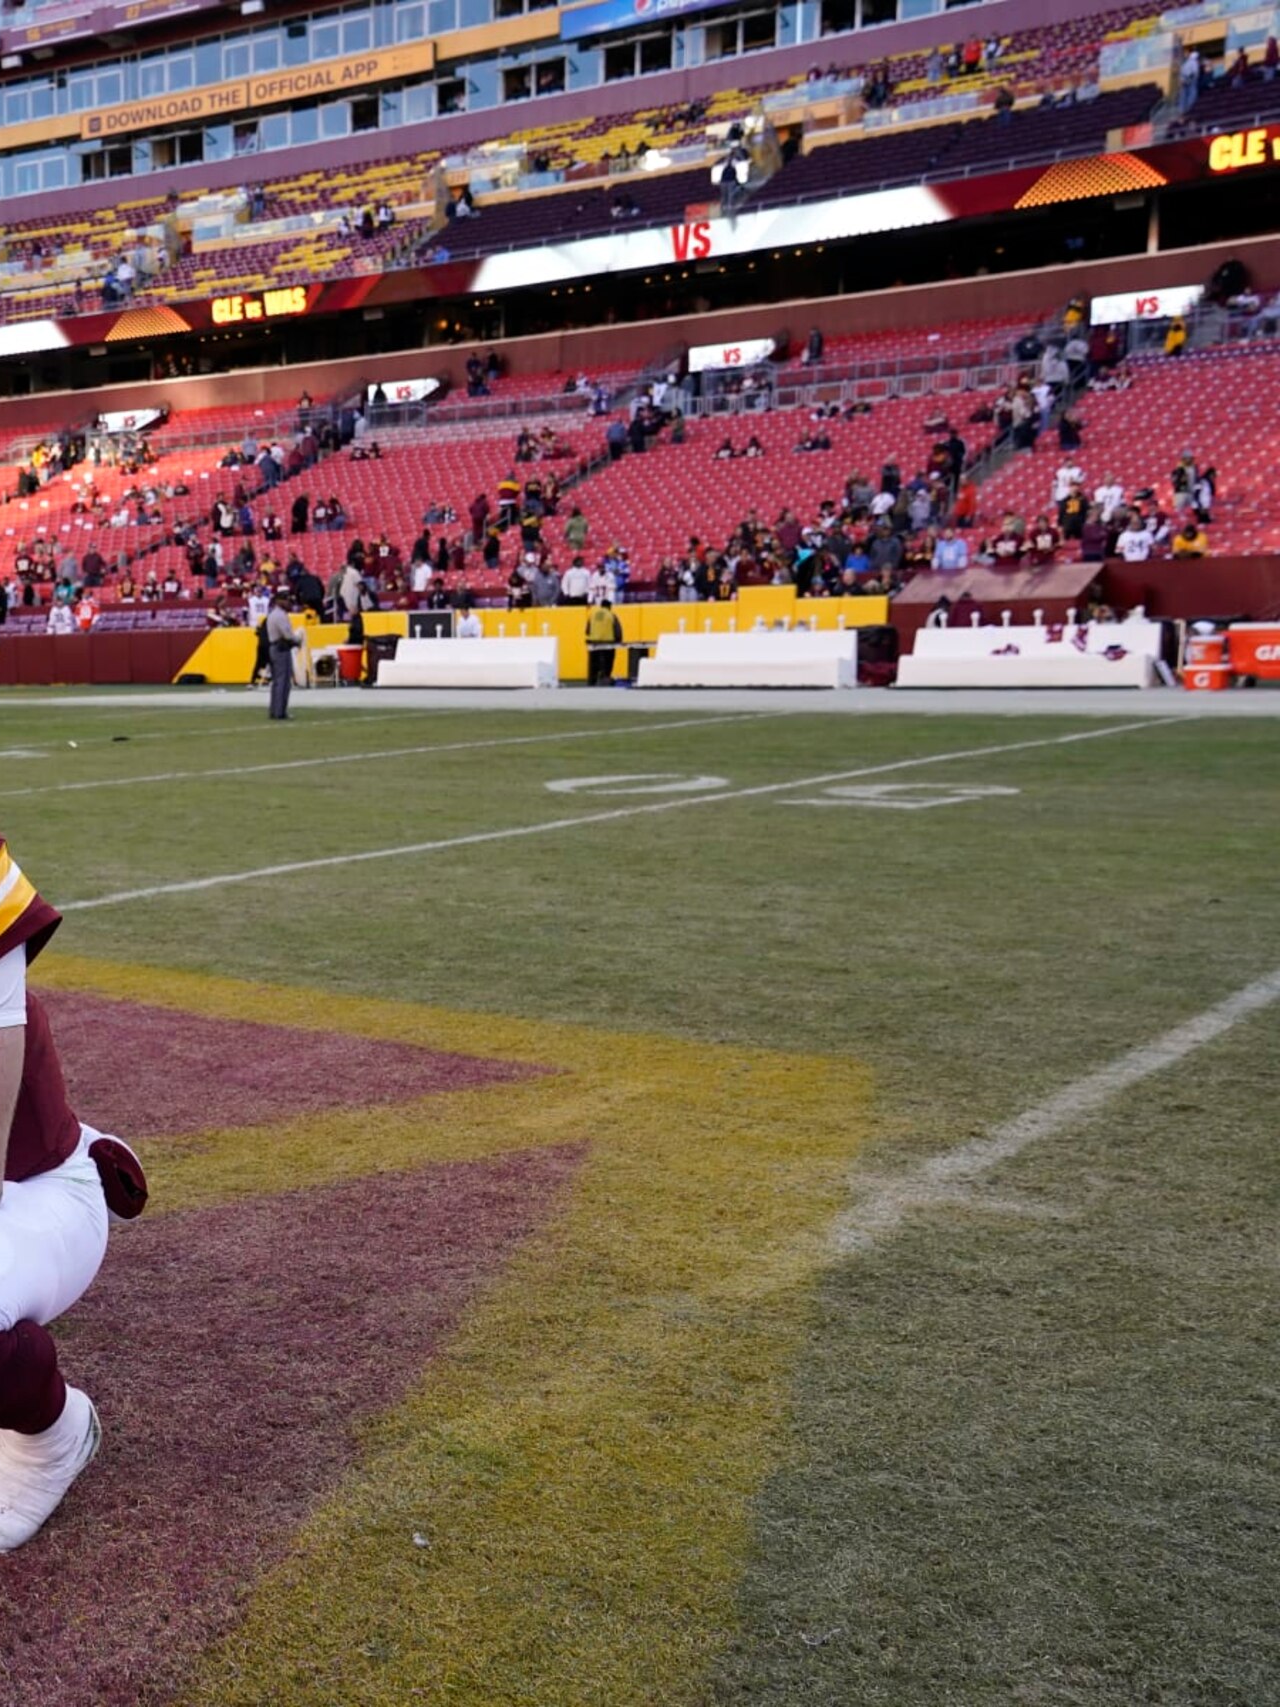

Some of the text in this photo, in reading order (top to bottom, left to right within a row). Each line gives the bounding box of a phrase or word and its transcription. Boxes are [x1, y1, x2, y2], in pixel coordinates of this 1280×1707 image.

[107, 92, 202, 129] DOWNLOAD
[207, 88, 241, 110] THE
[255, 69, 335, 100] OFFICIAL
[340, 59, 379, 82] APP
[1209, 128, 1267, 171] CLE
[671, 222, 711, 262] VS
[1136, 296, 1158, 315] VS
[723, 347, 741, 364] VS
